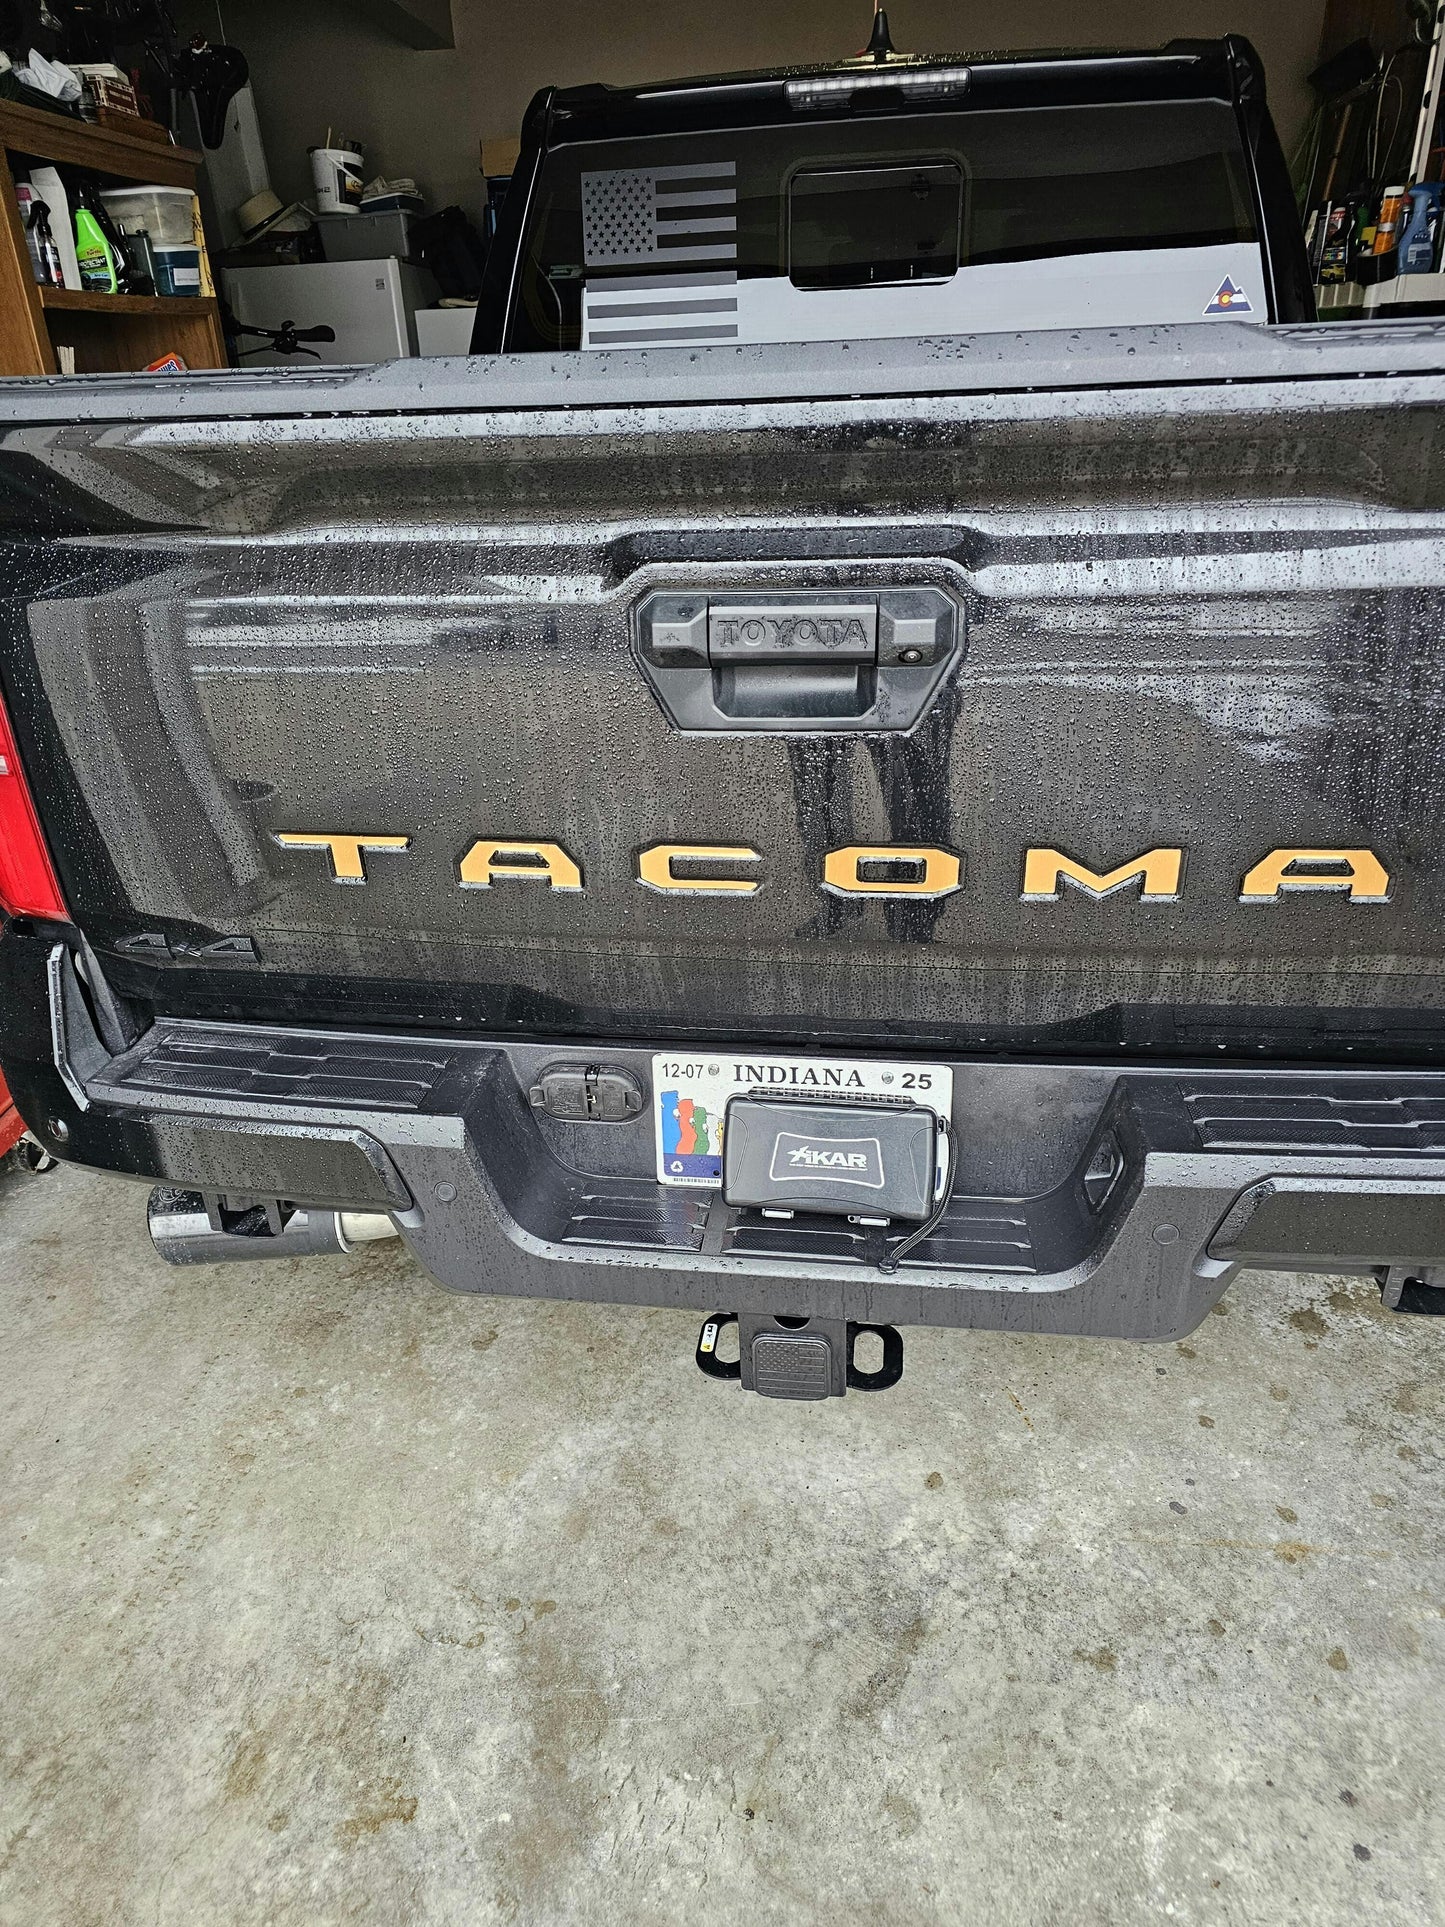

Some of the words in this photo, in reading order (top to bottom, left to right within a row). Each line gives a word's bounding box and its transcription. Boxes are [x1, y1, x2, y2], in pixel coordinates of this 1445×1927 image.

[716, 619, 869, 648] TOYOTA
[275, 832, 1391, 904] TACOMA
[662, 1063, 704, 1079] 12-07
[733, 1064, 866, 1088] INDIANA
[901, 1072, 933, 1090] 25
